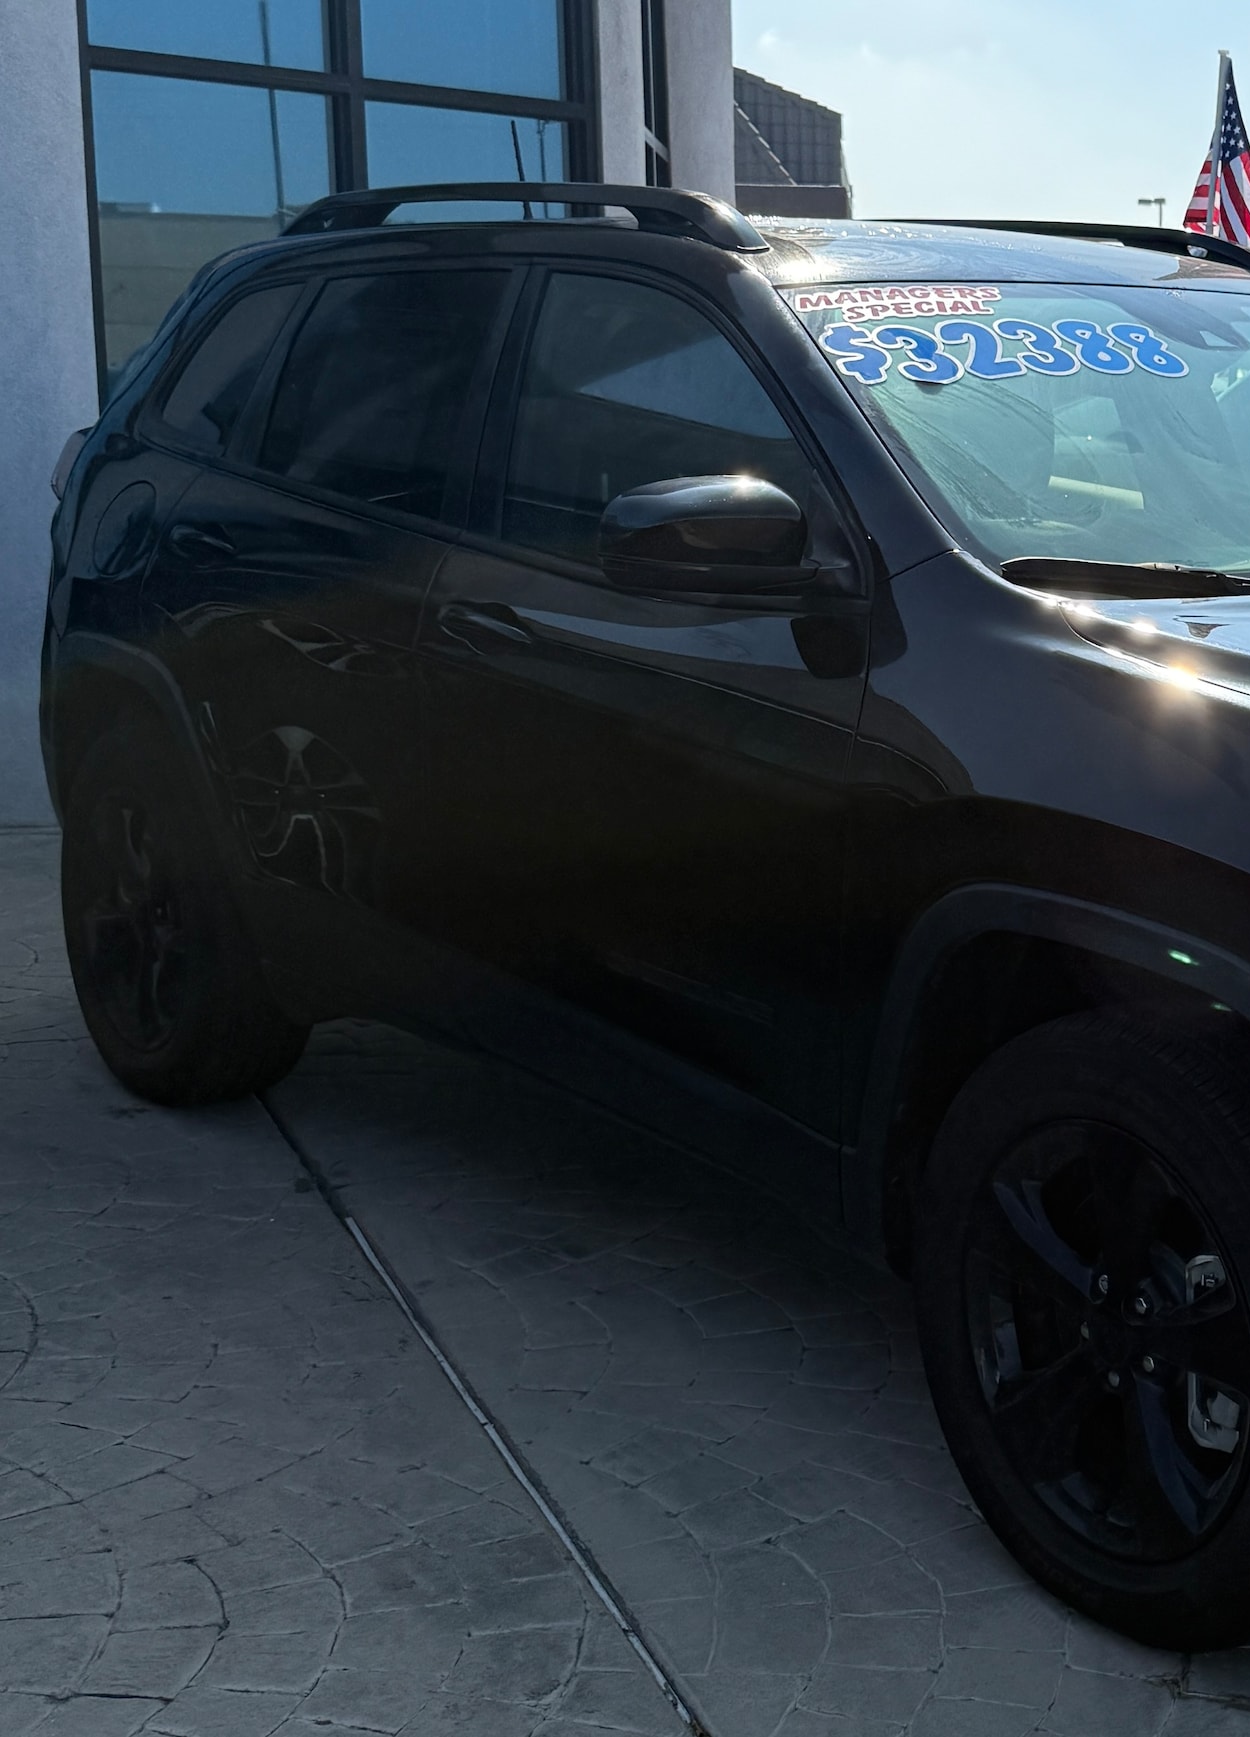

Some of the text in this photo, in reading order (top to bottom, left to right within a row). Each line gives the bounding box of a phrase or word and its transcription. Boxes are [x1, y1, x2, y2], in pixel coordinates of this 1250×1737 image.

[799, 286, 1000, 311] MANAGERS
[845, 299, 992, 321] SPECIAL
[820, 319, 1189, 385] $32388
